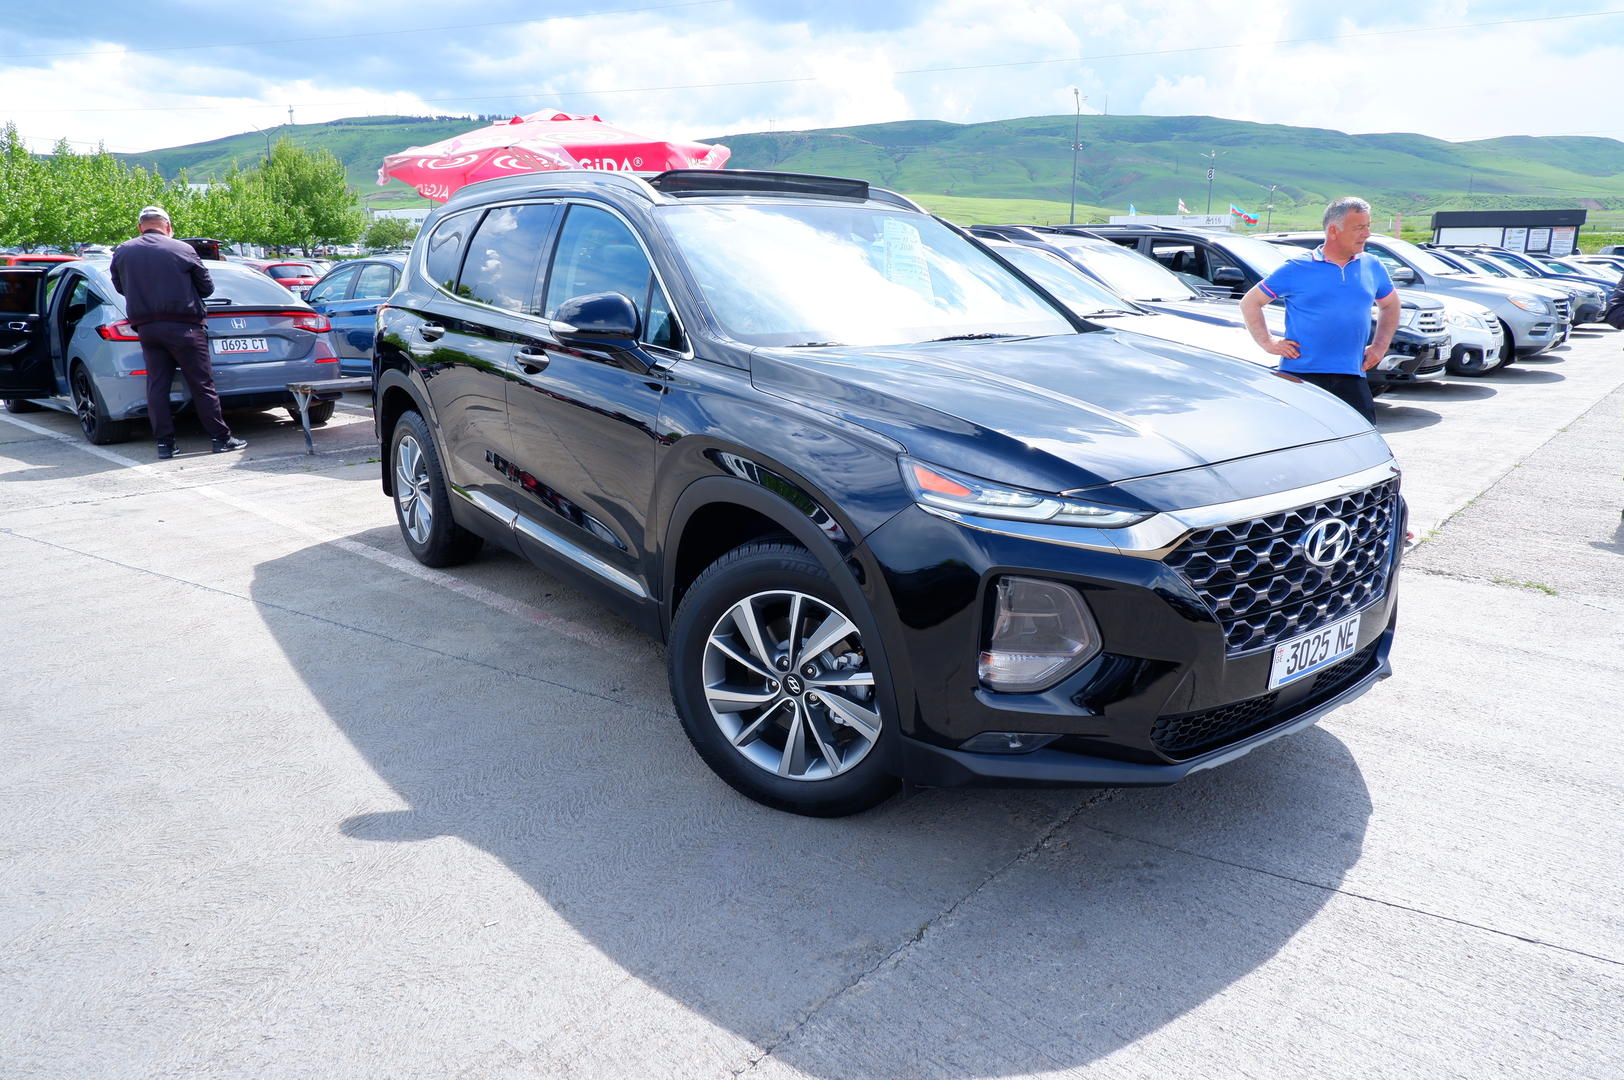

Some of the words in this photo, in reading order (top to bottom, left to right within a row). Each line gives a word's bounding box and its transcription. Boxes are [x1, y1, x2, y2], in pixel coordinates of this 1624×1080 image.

[221, 340, 248, 351] 0693
[251, 339, 265, 350] CT
[1286, 629, 1332, 675] 3025
[1334, 618, 1357, 655] NE
